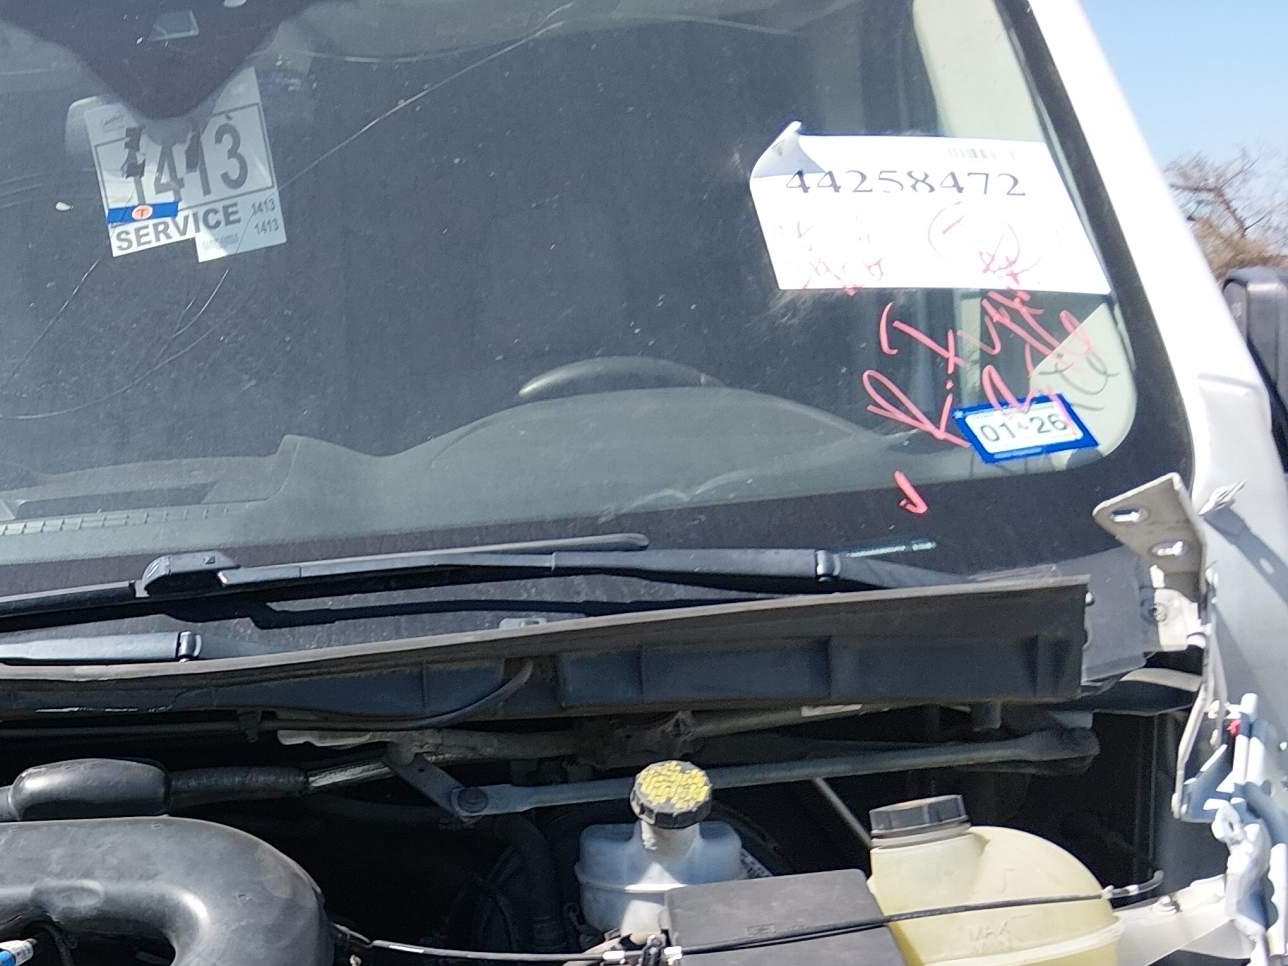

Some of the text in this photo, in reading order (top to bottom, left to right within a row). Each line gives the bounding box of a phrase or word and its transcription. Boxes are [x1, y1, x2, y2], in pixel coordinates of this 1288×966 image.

[785, 168, 1027, 197] 44258472
[115, 201, 241, 251] SERVICE
[254, 218, 280, 235] 1413
